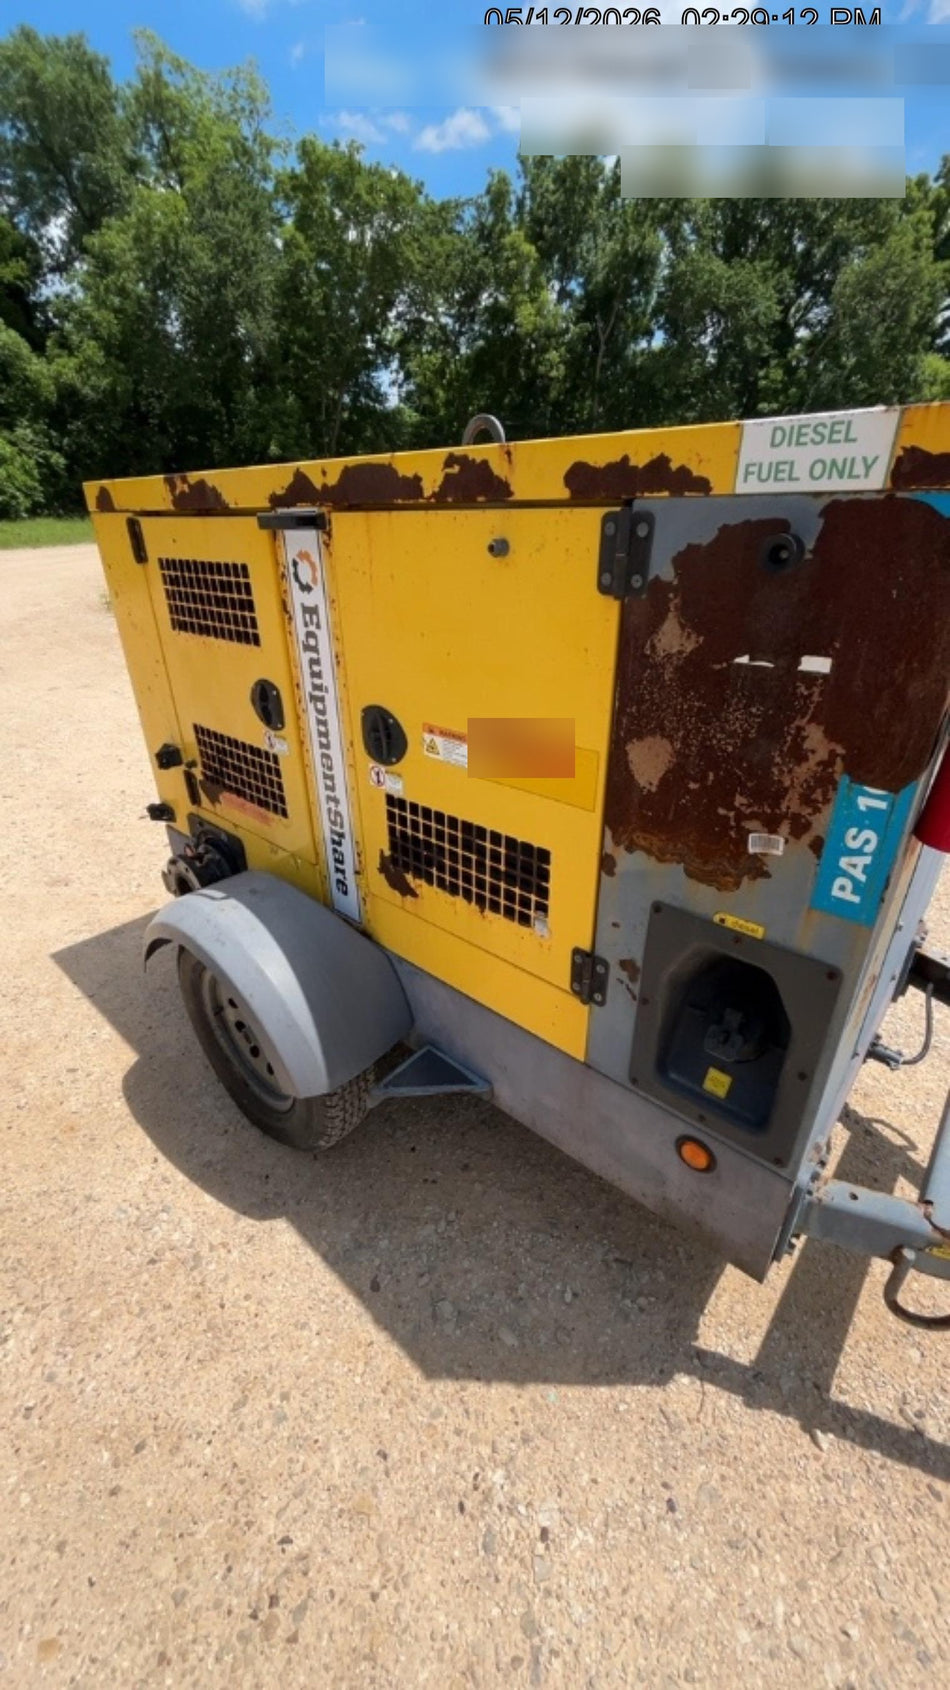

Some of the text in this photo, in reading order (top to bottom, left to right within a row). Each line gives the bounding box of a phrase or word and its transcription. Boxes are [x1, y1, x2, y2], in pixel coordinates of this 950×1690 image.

[743, 455, 880, 484] FUEL ONLY
[769, 419, 858, 449] DIESEL
[300, 602, 349, 897] EquipmentShare
[830, 785, 889, 904] PAS 1
